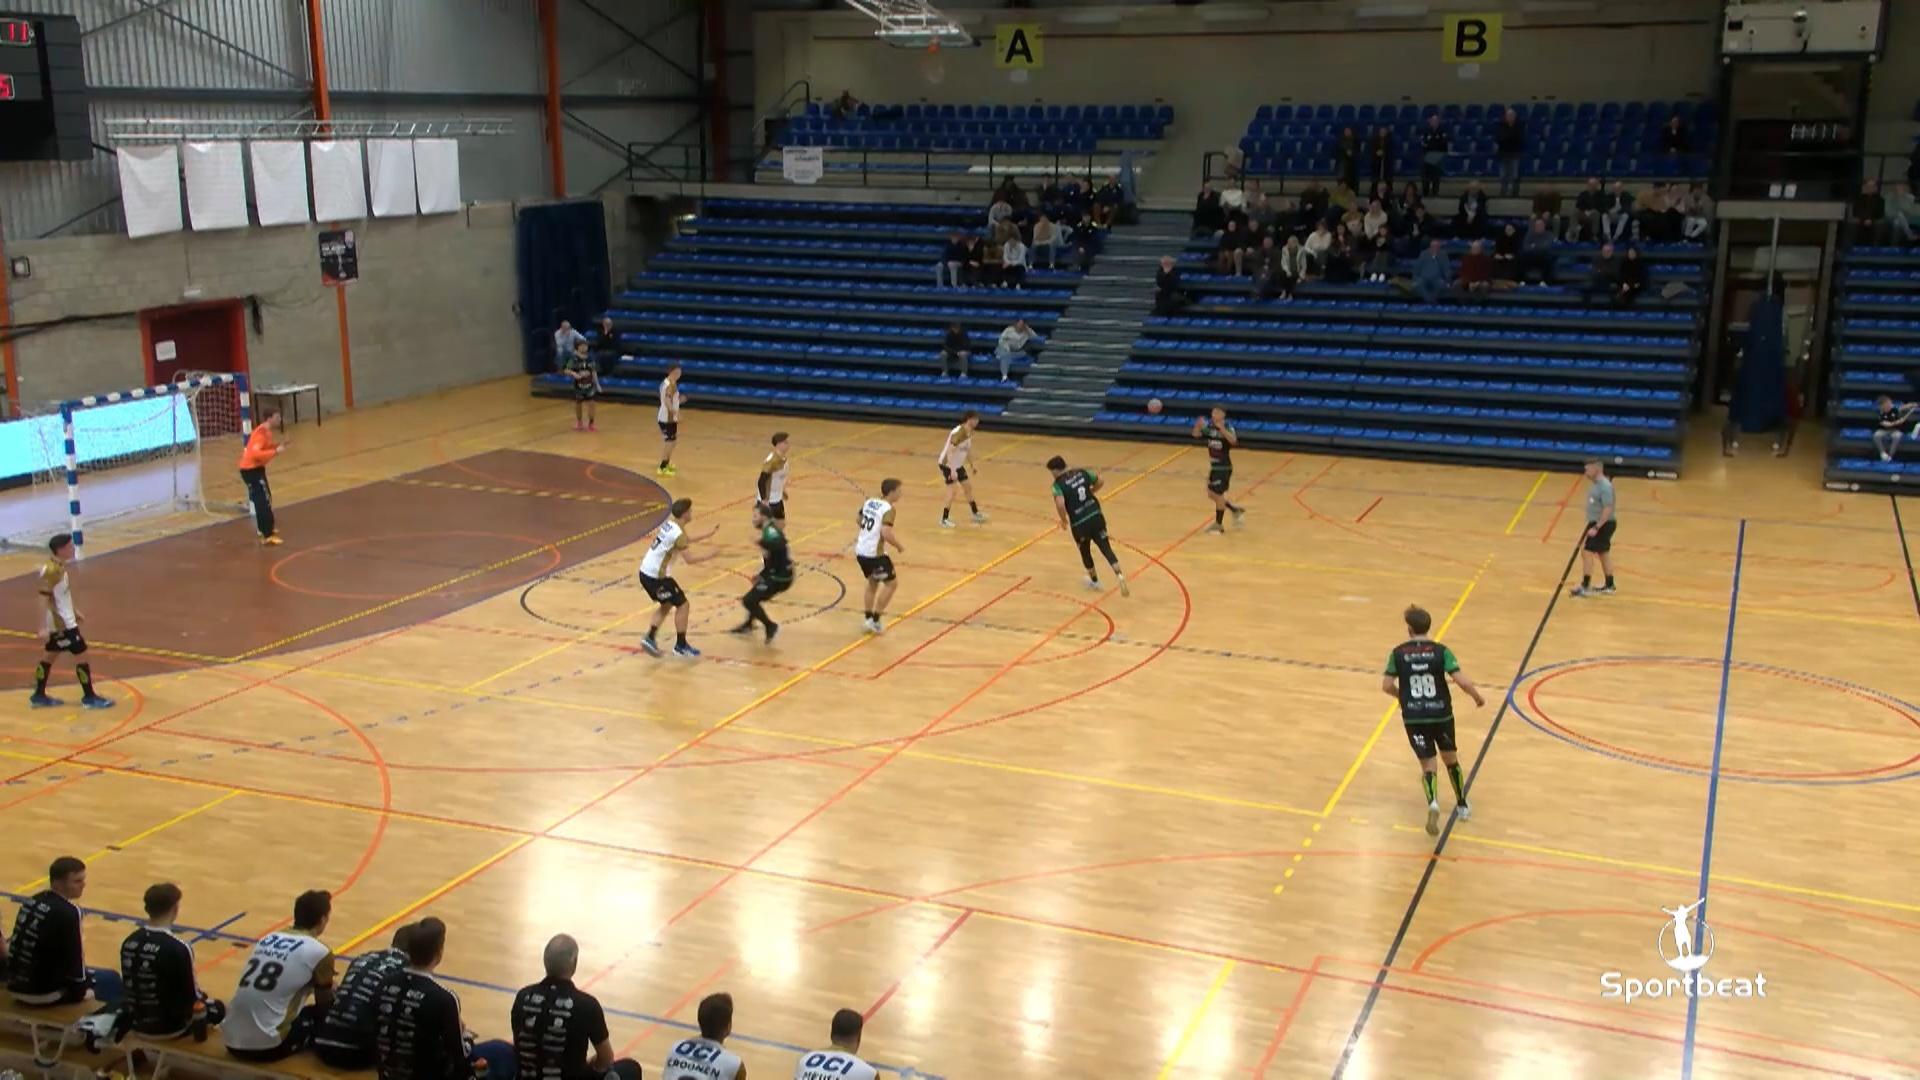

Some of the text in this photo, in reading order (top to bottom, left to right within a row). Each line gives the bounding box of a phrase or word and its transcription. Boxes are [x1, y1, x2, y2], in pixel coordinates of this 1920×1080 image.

[1005, 28, 1034, 64] A
[1455, 20, 1487, 57] B
[239, 958, 284, 992] 28
[675, 1041, 721, 1063] OCI
[805, 1053, 854, 1075] OCI
